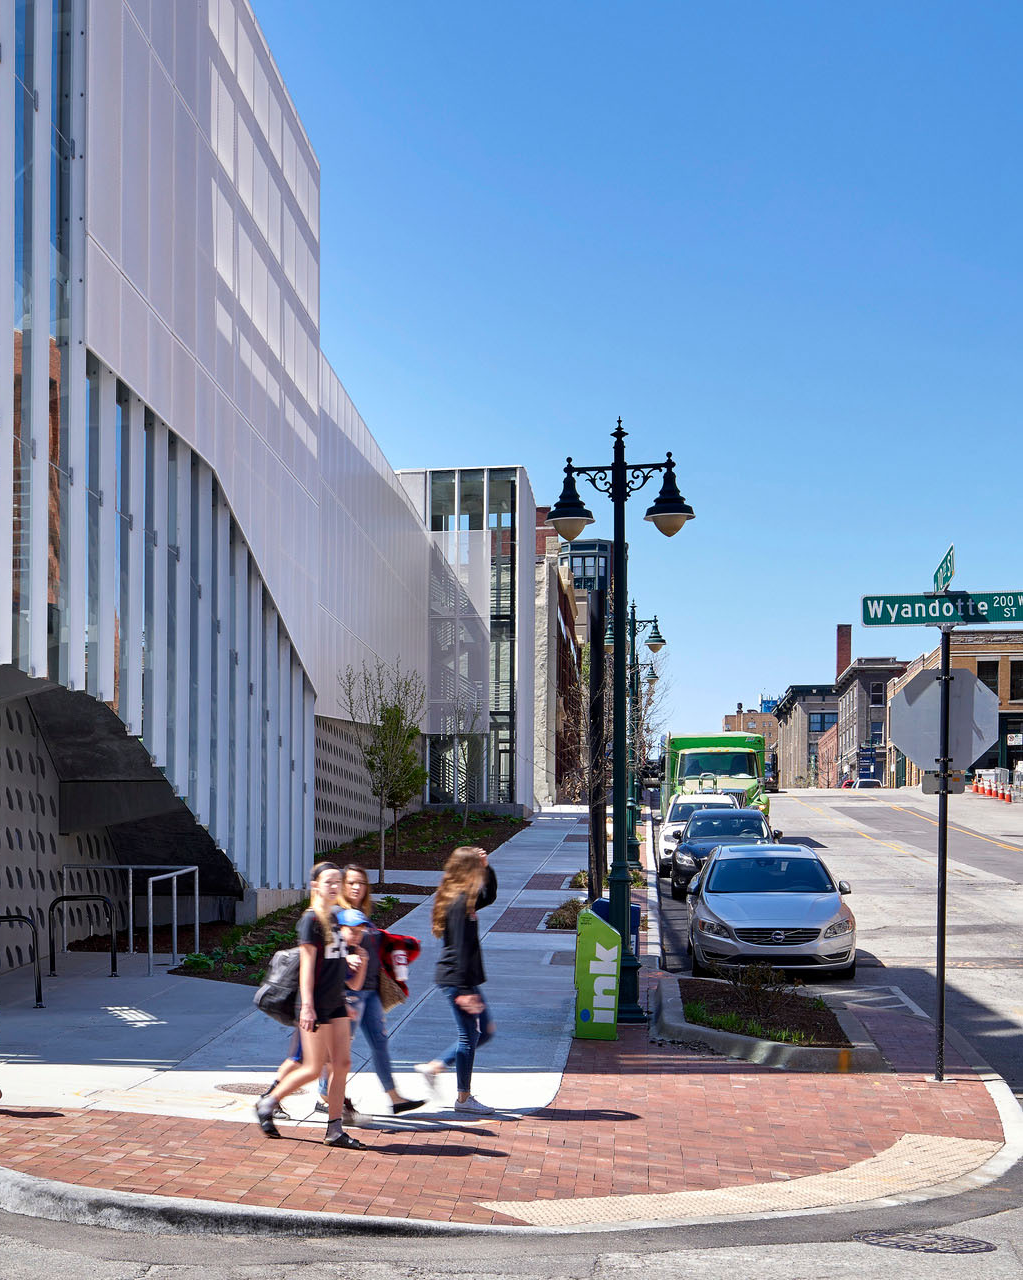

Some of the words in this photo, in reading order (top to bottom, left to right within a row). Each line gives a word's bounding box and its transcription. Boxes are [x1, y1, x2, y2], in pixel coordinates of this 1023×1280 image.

[867, 598, 988, 622] Wyandotte
[993, 596, 1014, 607] 200
[1003, 607, 1017, 618] ST
[580, 942, 619, 1024] ink
